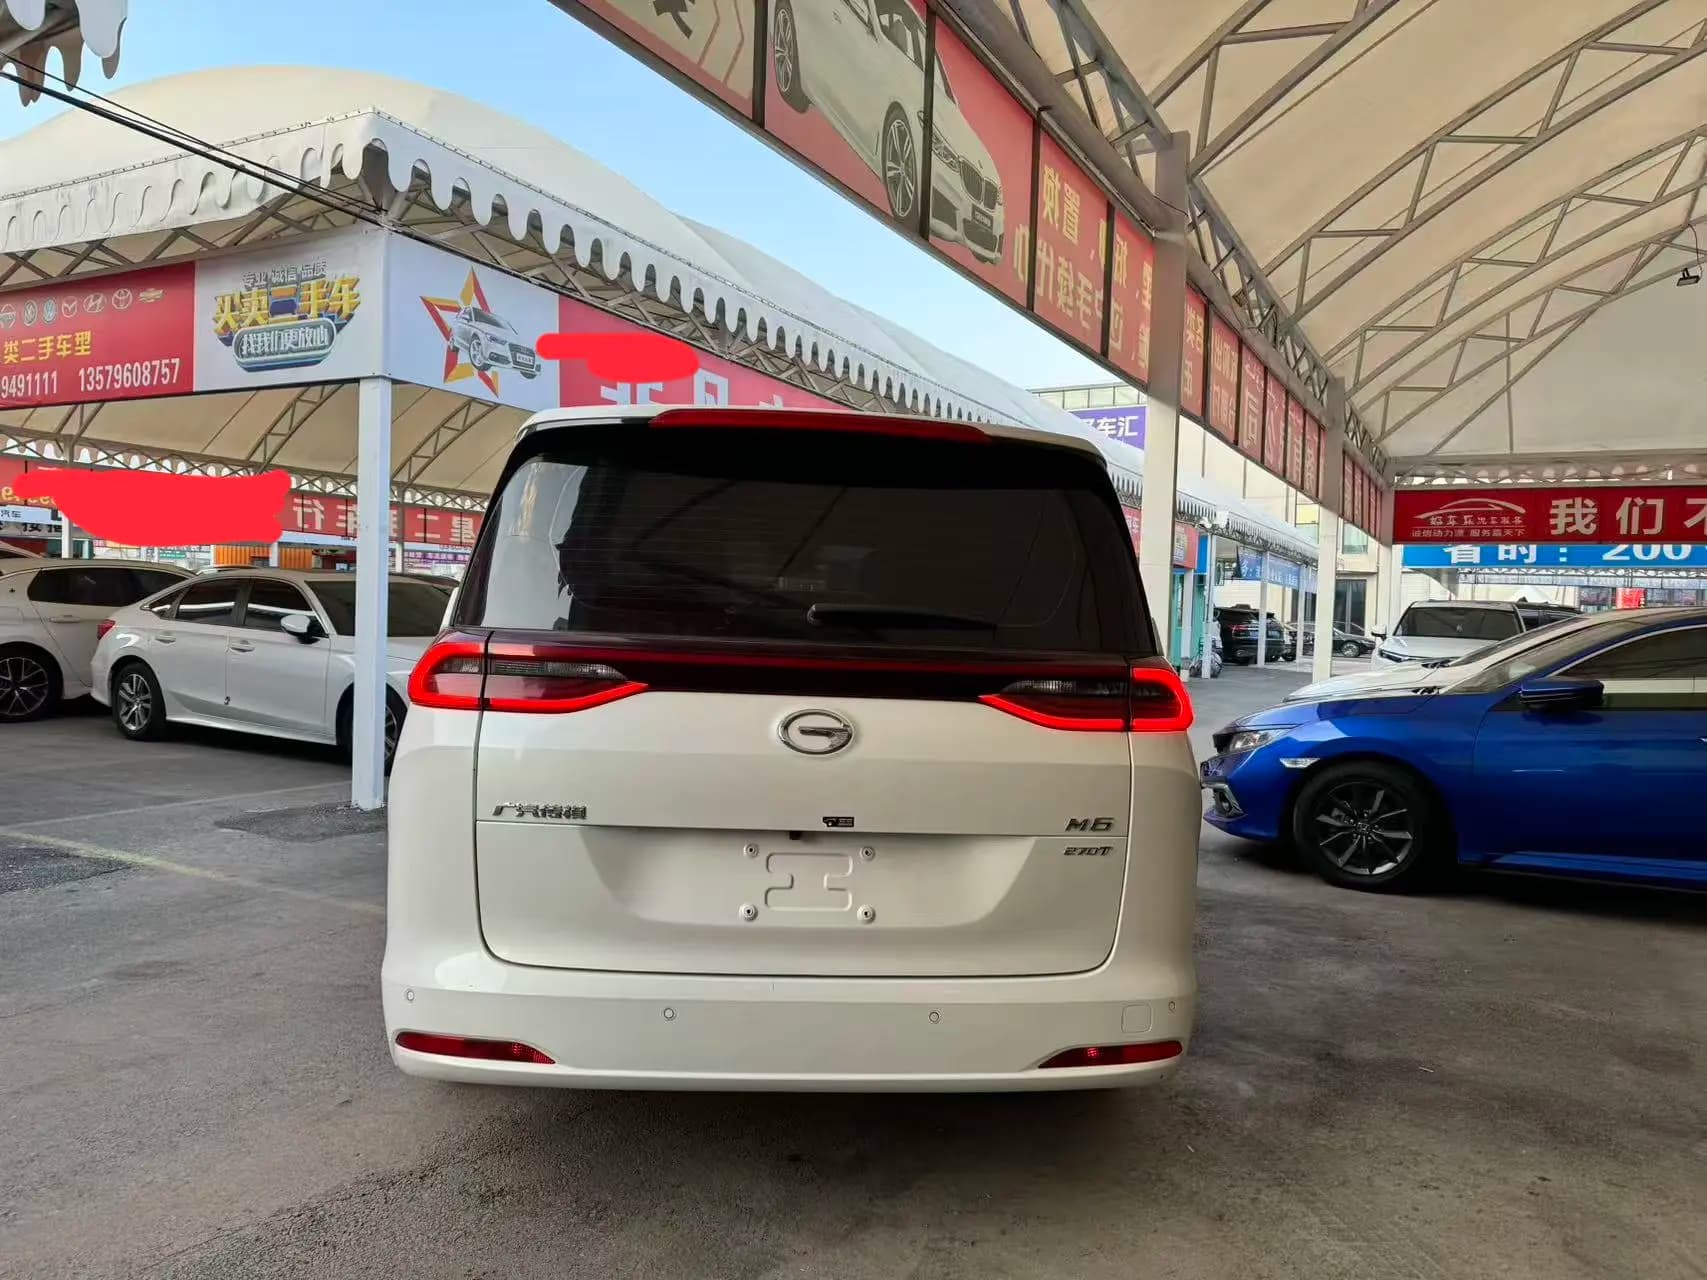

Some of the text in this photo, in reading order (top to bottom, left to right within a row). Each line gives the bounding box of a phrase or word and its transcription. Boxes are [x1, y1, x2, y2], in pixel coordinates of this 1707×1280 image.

[3, 331, 92, 364] 类二手车型
[1, 358, 181, 399] 9491111 13579608757
[1065, 817, 1115, 832] M6
[1063, 846, 1114, 856] 270T
